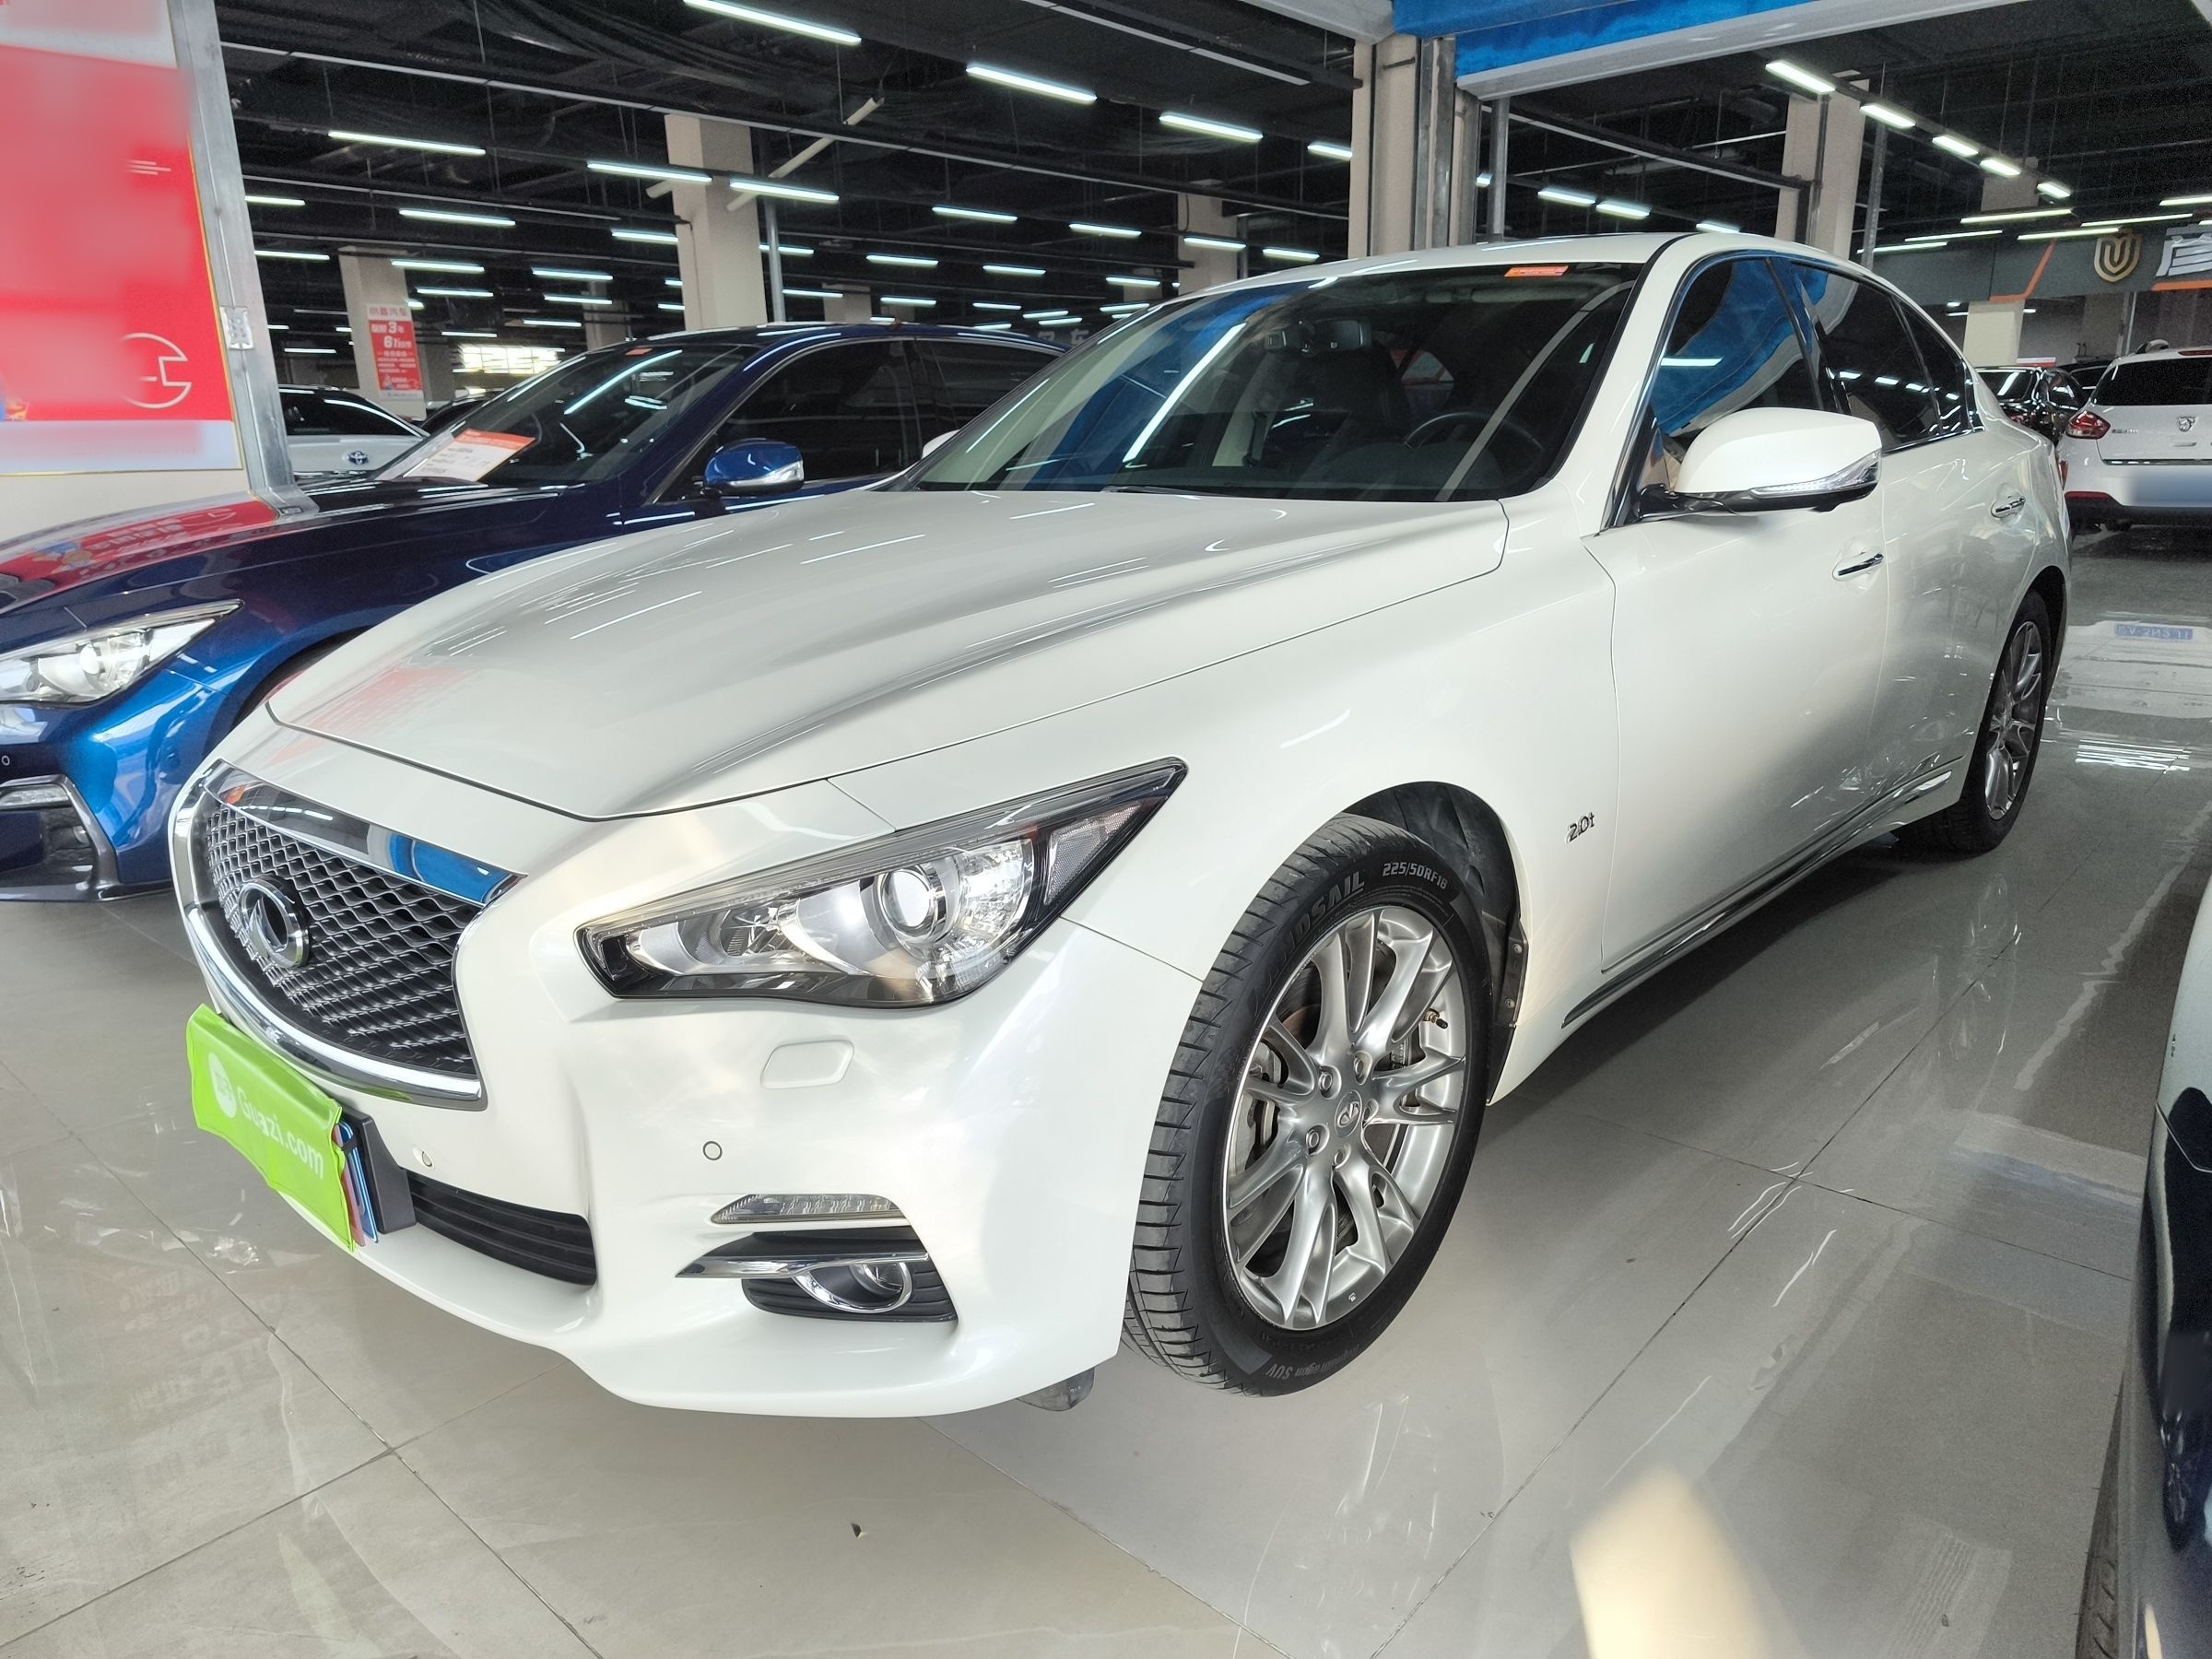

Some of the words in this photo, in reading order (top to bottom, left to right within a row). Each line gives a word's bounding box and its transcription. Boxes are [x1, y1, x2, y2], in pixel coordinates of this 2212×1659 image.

[1567, 811, 1595, 842] 2.0t
[237, 1086, 324, 1180] Guazi.com
[1265, 1363, 1294, 1380] SUV
